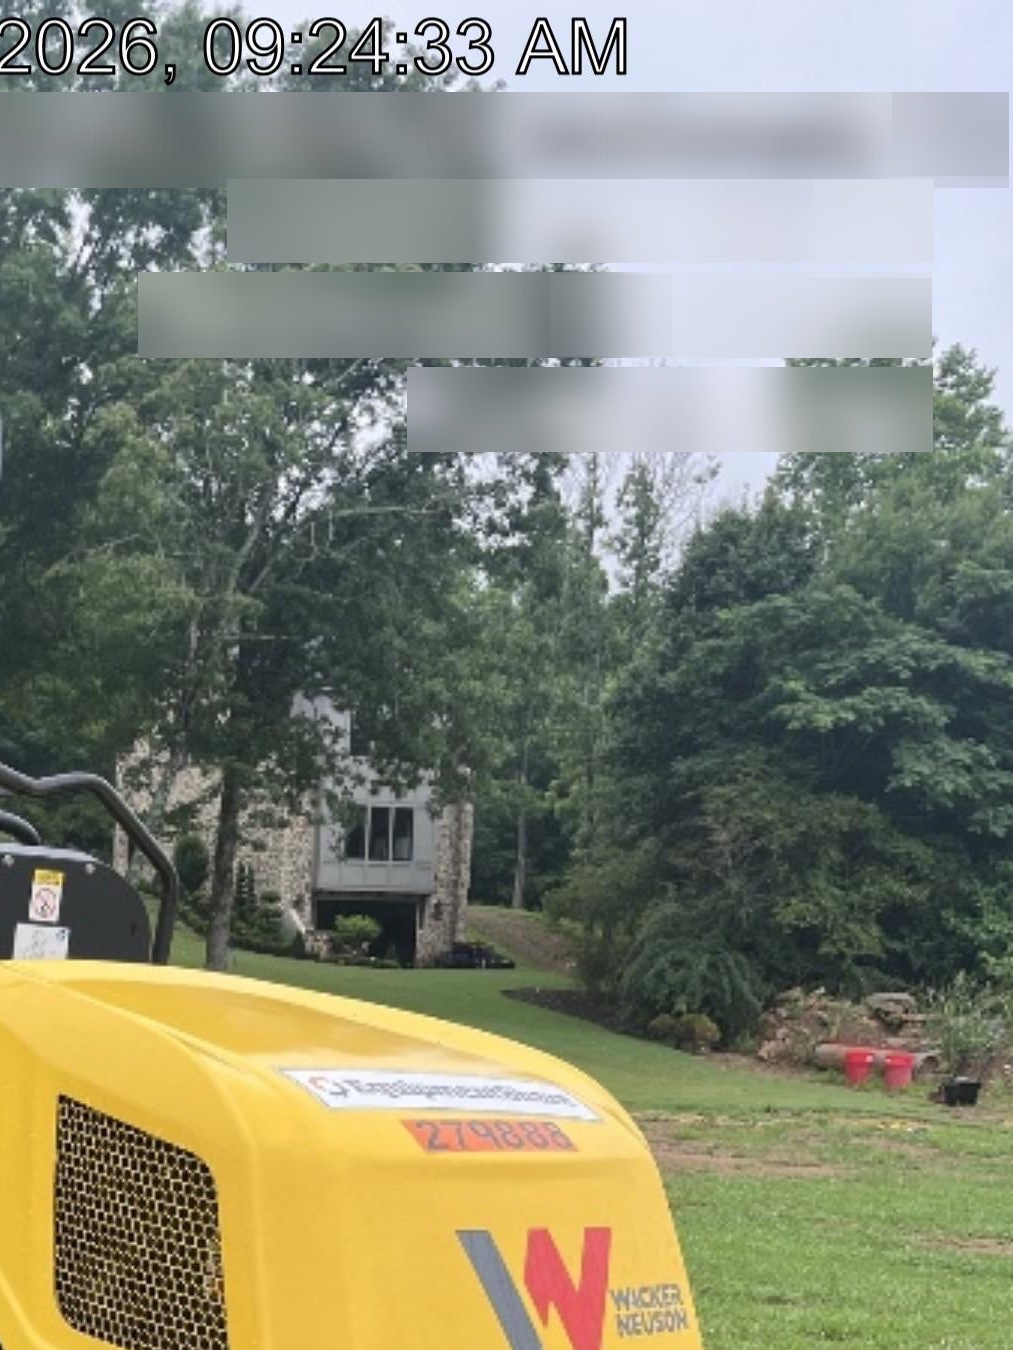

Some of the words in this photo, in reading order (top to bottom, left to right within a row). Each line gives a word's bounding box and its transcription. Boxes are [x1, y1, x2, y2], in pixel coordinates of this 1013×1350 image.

[416, 1119, 574, 1151] 279888
[610, 1283, 684, 1312] WACKER
[615, 1306, 690, 1338] NEUSON
